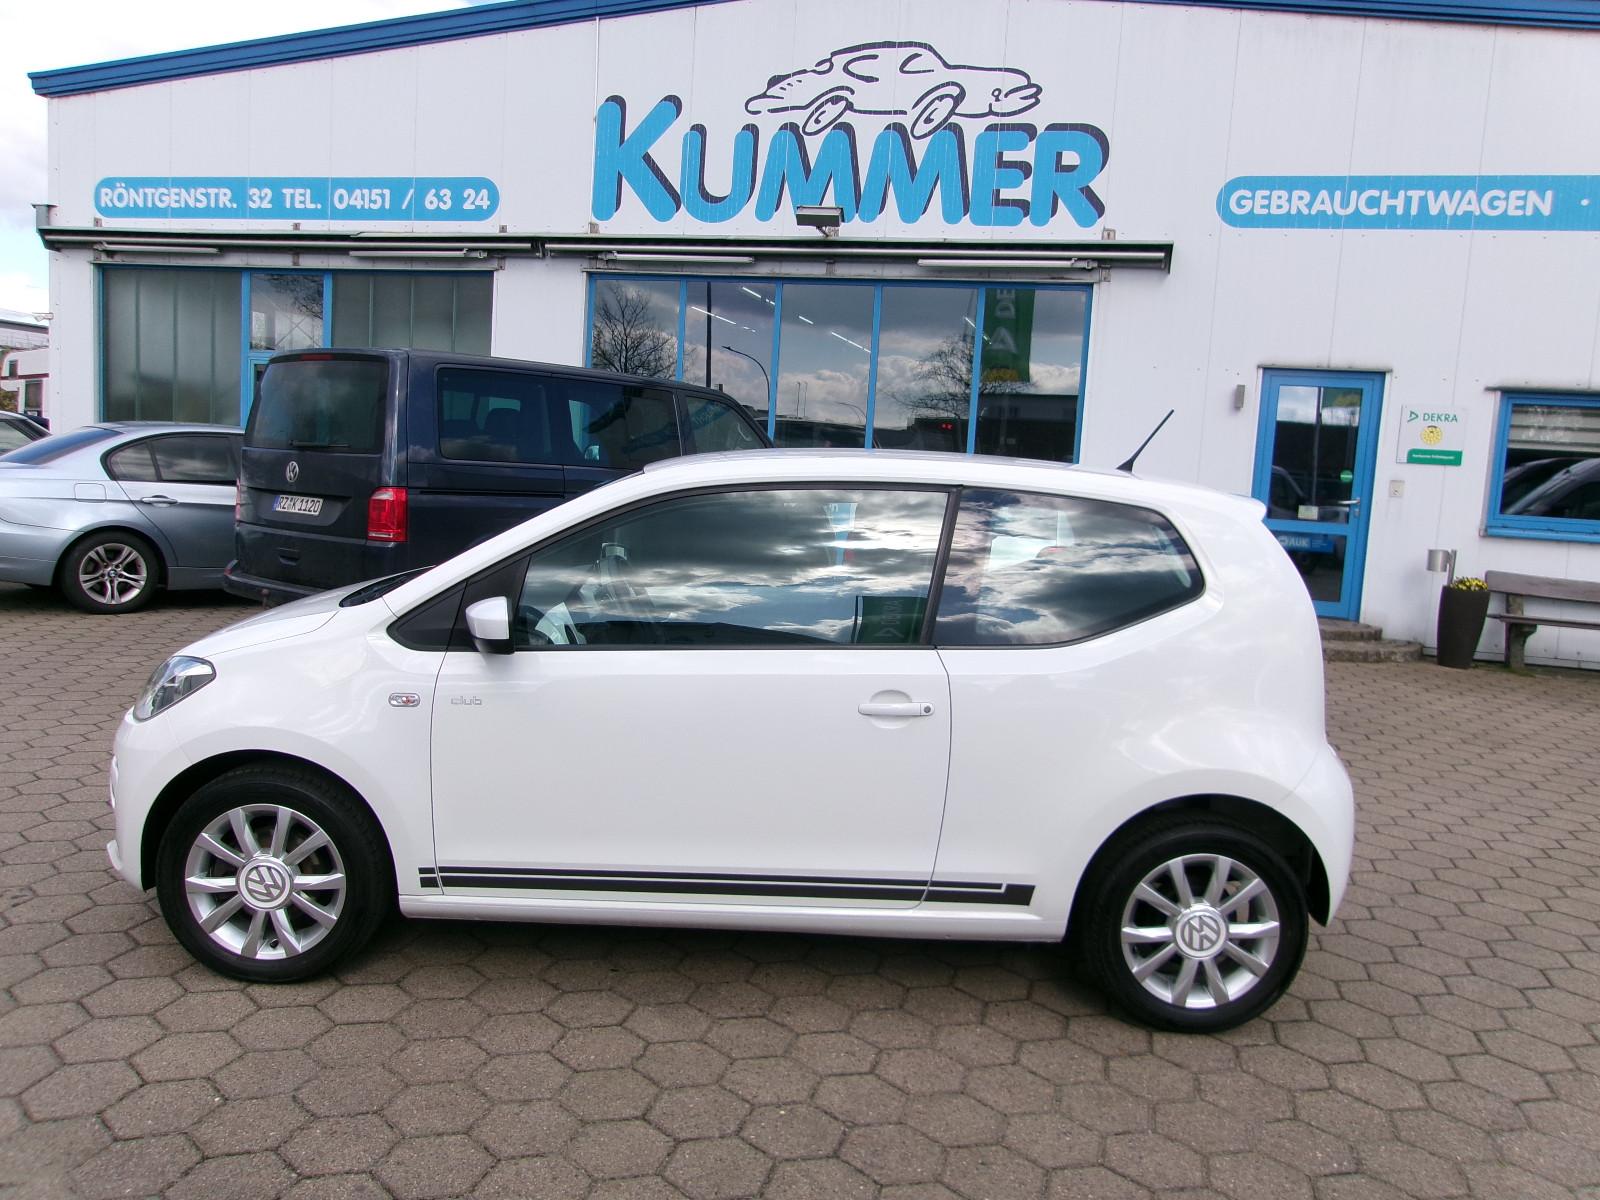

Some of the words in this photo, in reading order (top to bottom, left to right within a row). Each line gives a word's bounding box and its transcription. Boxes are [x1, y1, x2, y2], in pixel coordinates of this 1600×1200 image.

[592, 94, 1110, 228] KUMMER
[101, 183, 237, 208] RÖNTGENSTR.
[249, 188, 272, 208] 32
[282, 189, 322, 209] TEL.
[333, 188, 391, 209] 04151
[401, 189, 414, 209] /
[424, 188, 452, 210] 63
[462, 188, 490, 209] 24
[1229, 189, 1553, 217] GEBRAUCHTWAGEN
[1422, 412, 1458, 423] DEKRA
[298, 499, 321, 513] 1120
[450, 695, 483, 706] club
